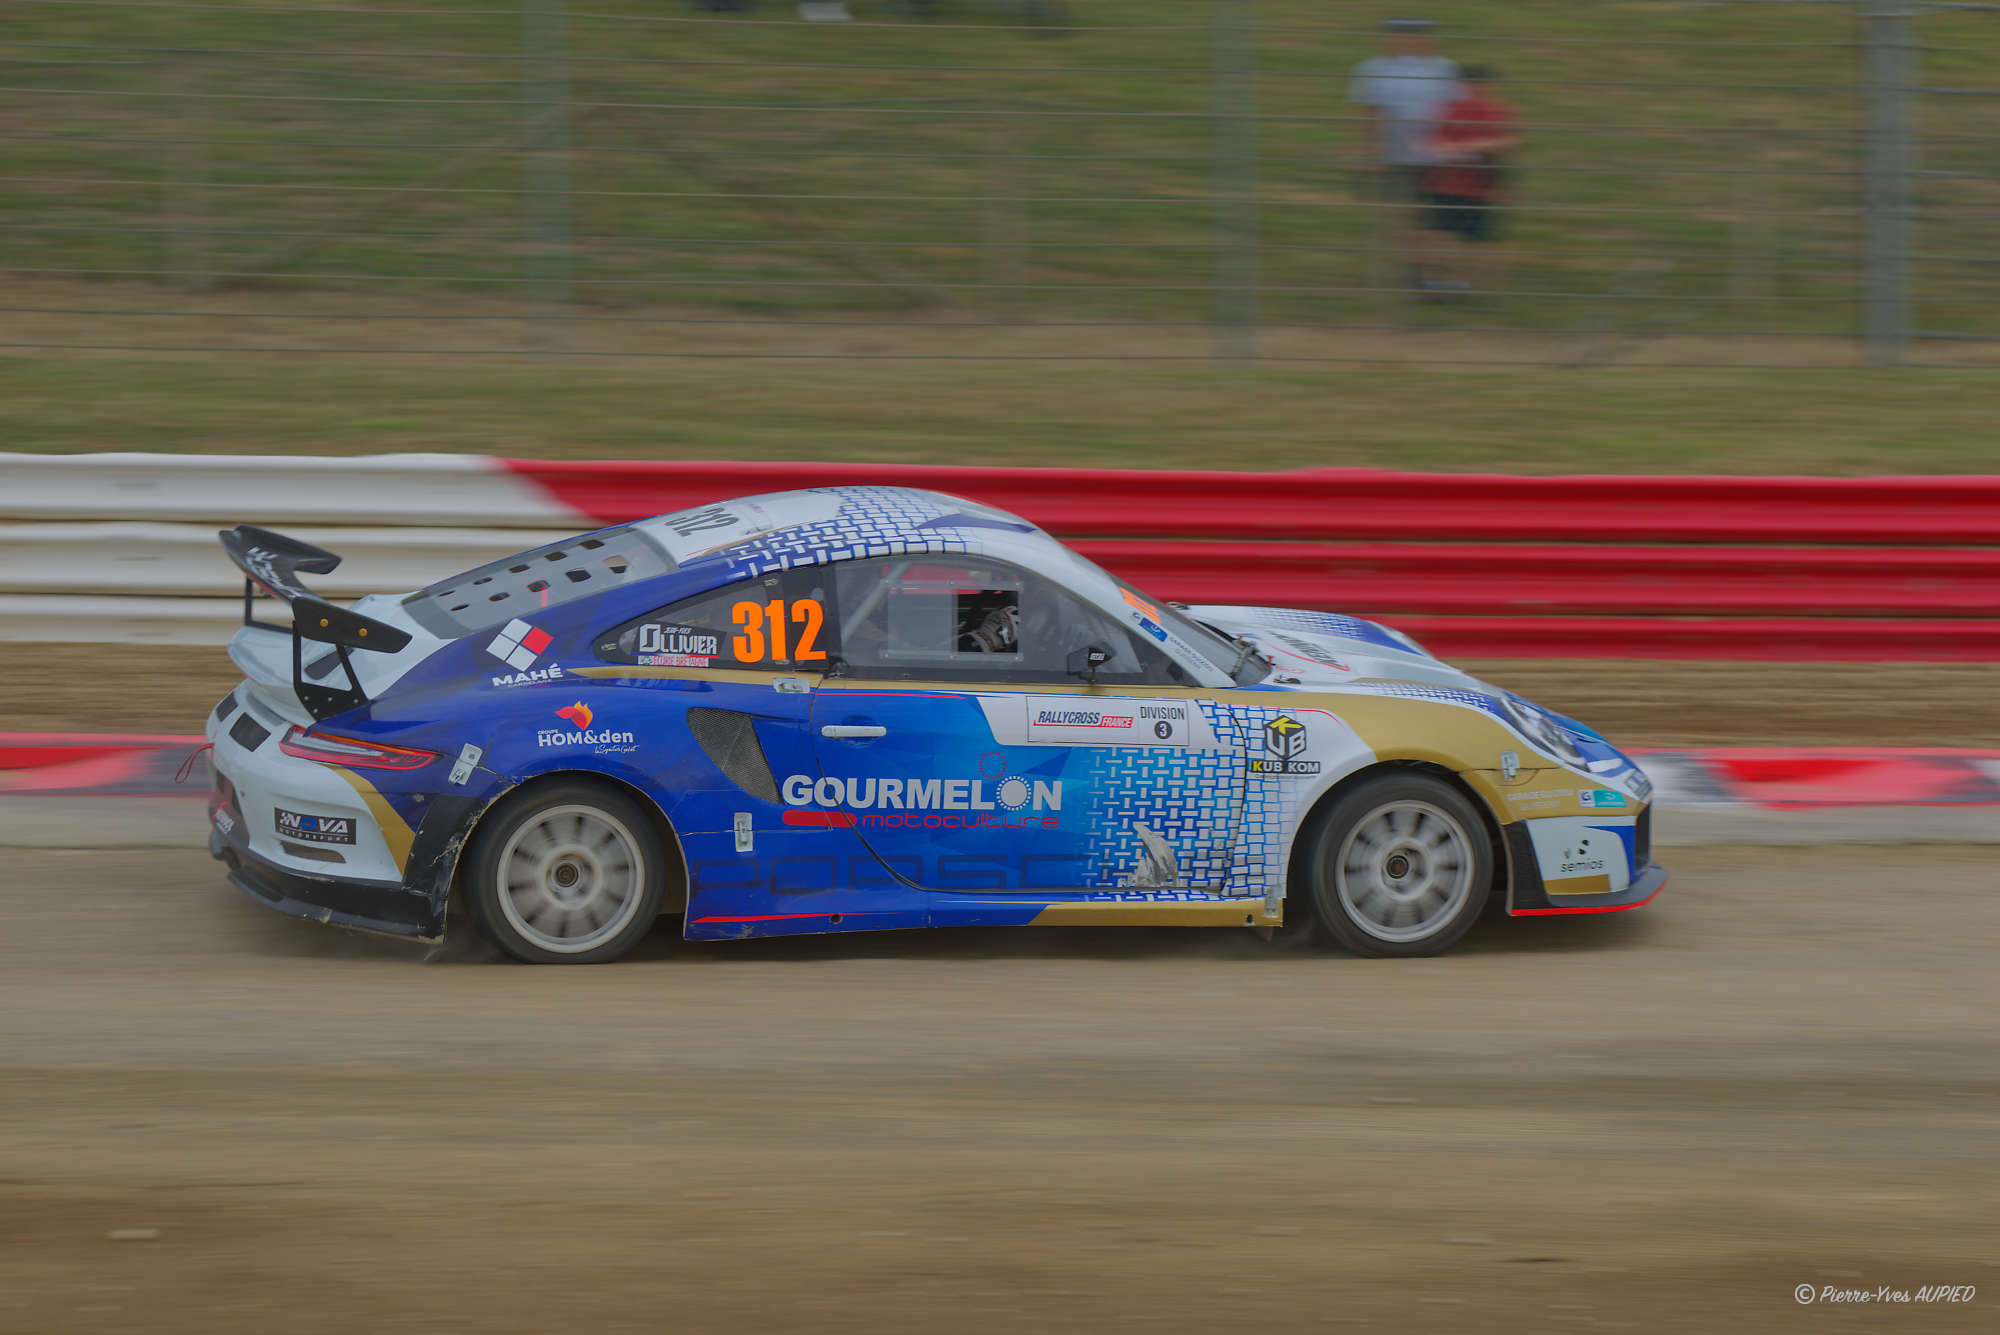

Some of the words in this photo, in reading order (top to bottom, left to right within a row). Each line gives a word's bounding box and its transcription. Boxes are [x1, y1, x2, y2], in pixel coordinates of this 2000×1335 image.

[663, 507, 739, 538] 312
[639, 623, 718, 655] OLLIVIER
[732, 599, 827, 663] 312
[492, 662, 564, 687] MAHÉ
[1037, 710, 1101, 725] RALLYCROSS
[1100, 715, 1134, 729] FRANCE
[1139, 706, 1186, 721] DIVISION
[537, 729, 634, 747] HOM&den
[1252, 760, 1283, 773] KUB
[1287, 761, 1320, 773] KOM
[781, 774, 1063, 812] GOURMELON
[279, 811, 349, 834] NOVA
[861, 810, 1061, 830] motoculture
[1560, 858, 1605, 873] semios
